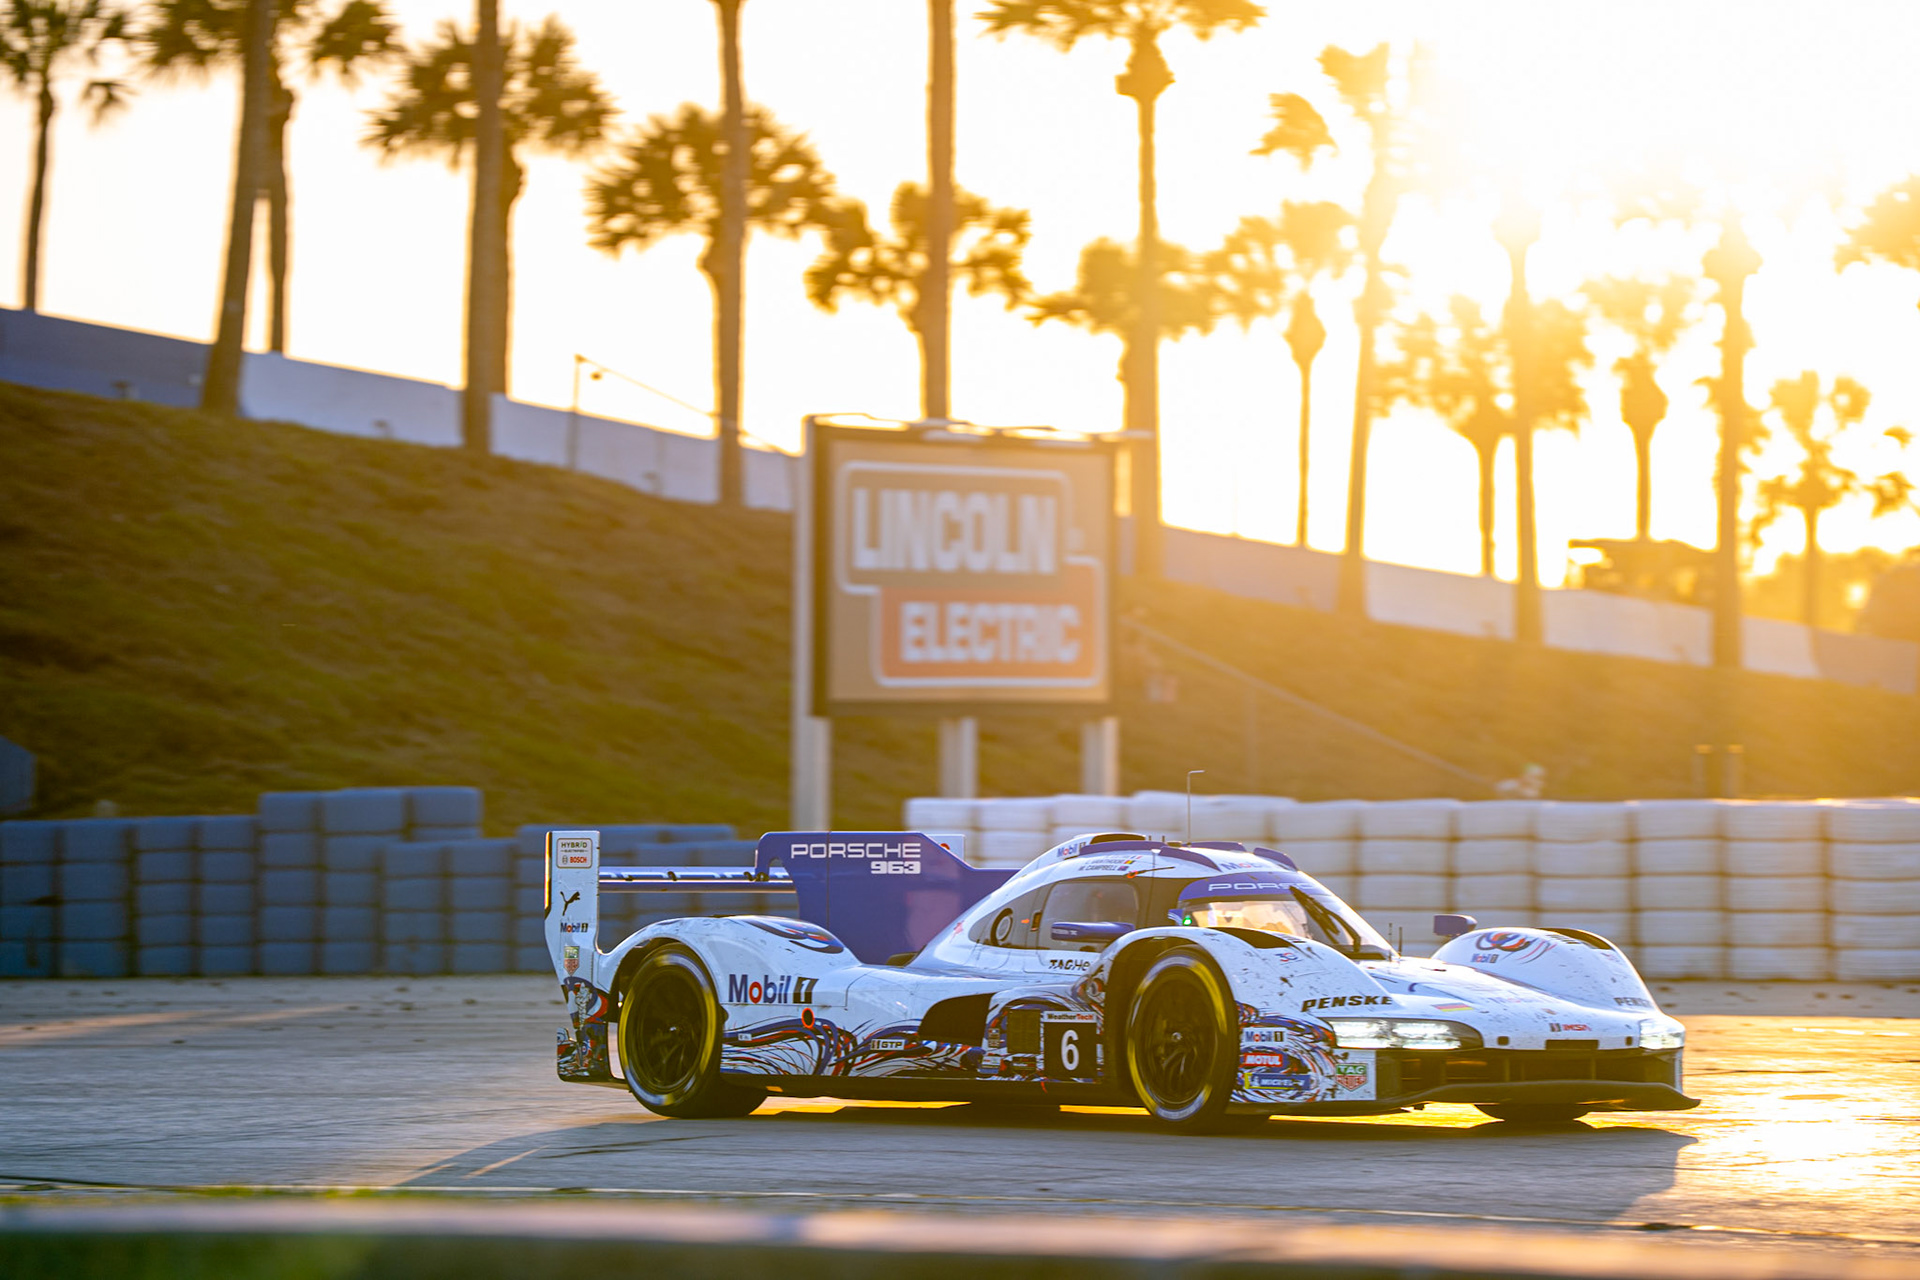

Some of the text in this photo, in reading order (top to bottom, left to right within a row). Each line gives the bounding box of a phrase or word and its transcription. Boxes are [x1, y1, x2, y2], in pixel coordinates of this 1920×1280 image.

[852, 487, 1058, 574] LINCOLN
[901, 602, 1080, 663] ELECTRIC
[791, 843, 921, 859] PORSCHE
[870, 861, 921, 874] 963
[560, 922, 580, 933] Mobil
[728, 974, 792, 1004] Mobil
[1301, 995, 1393, 1012] PENSKE
[1245, 1031, 1272, 1042] Mobil
[881, 1041, 903, 1049] GTP
[1061, 1030, 1079, 1070] 6
[1245, 1055, 1282, 1066] MOTUL
[1338, 1066, 1365, 1075] TAG
